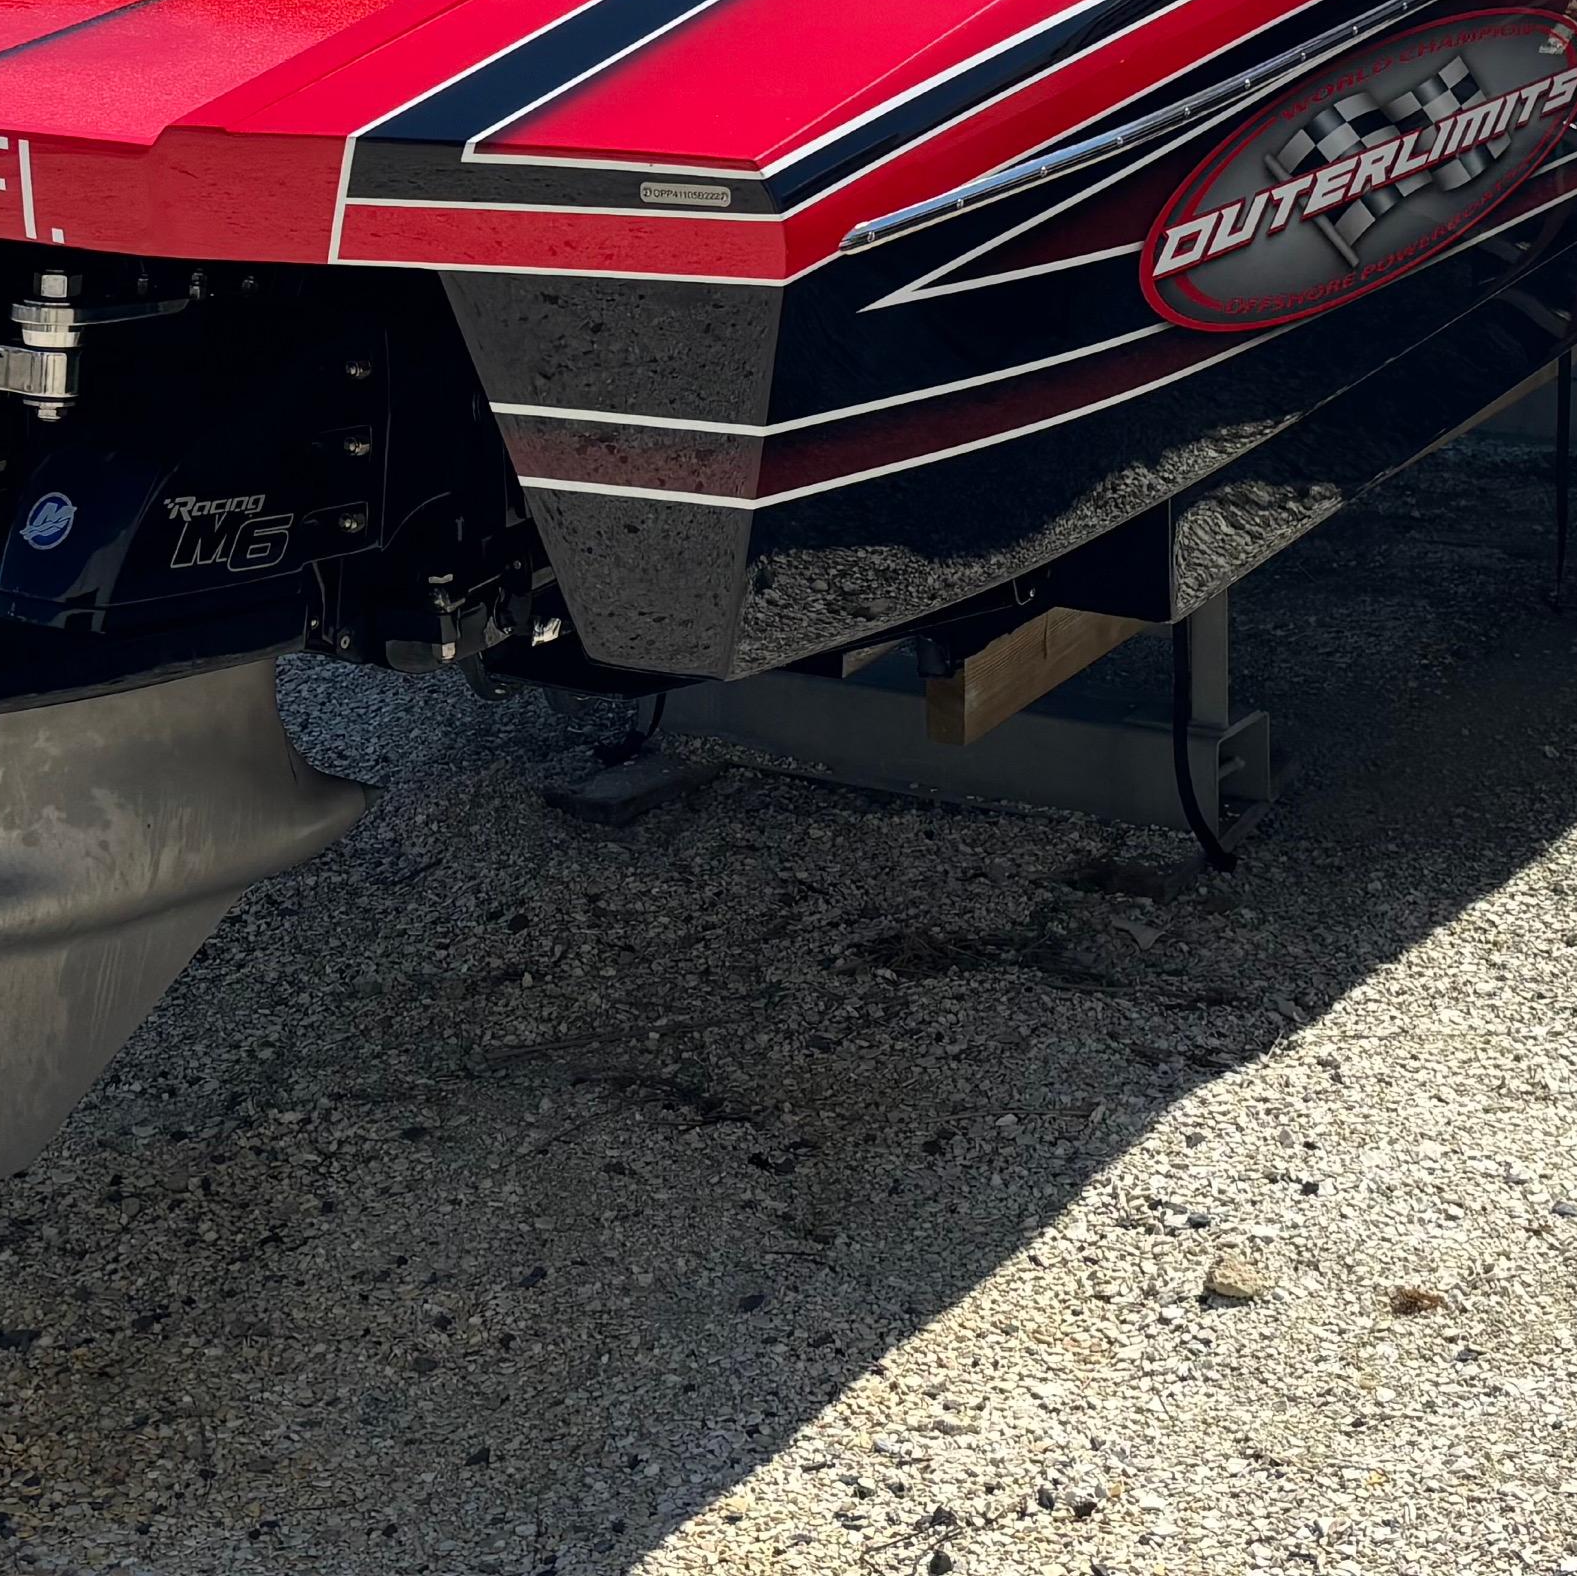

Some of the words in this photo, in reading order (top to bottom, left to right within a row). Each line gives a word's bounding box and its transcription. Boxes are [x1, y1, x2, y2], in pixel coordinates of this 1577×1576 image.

[1280, 55, 1395, 122] WORLD
[1225, 271, 1356, 315] OFFSHORE
[169, 494, 266, 522] Racing
[170, 512, 295, 572] M6
